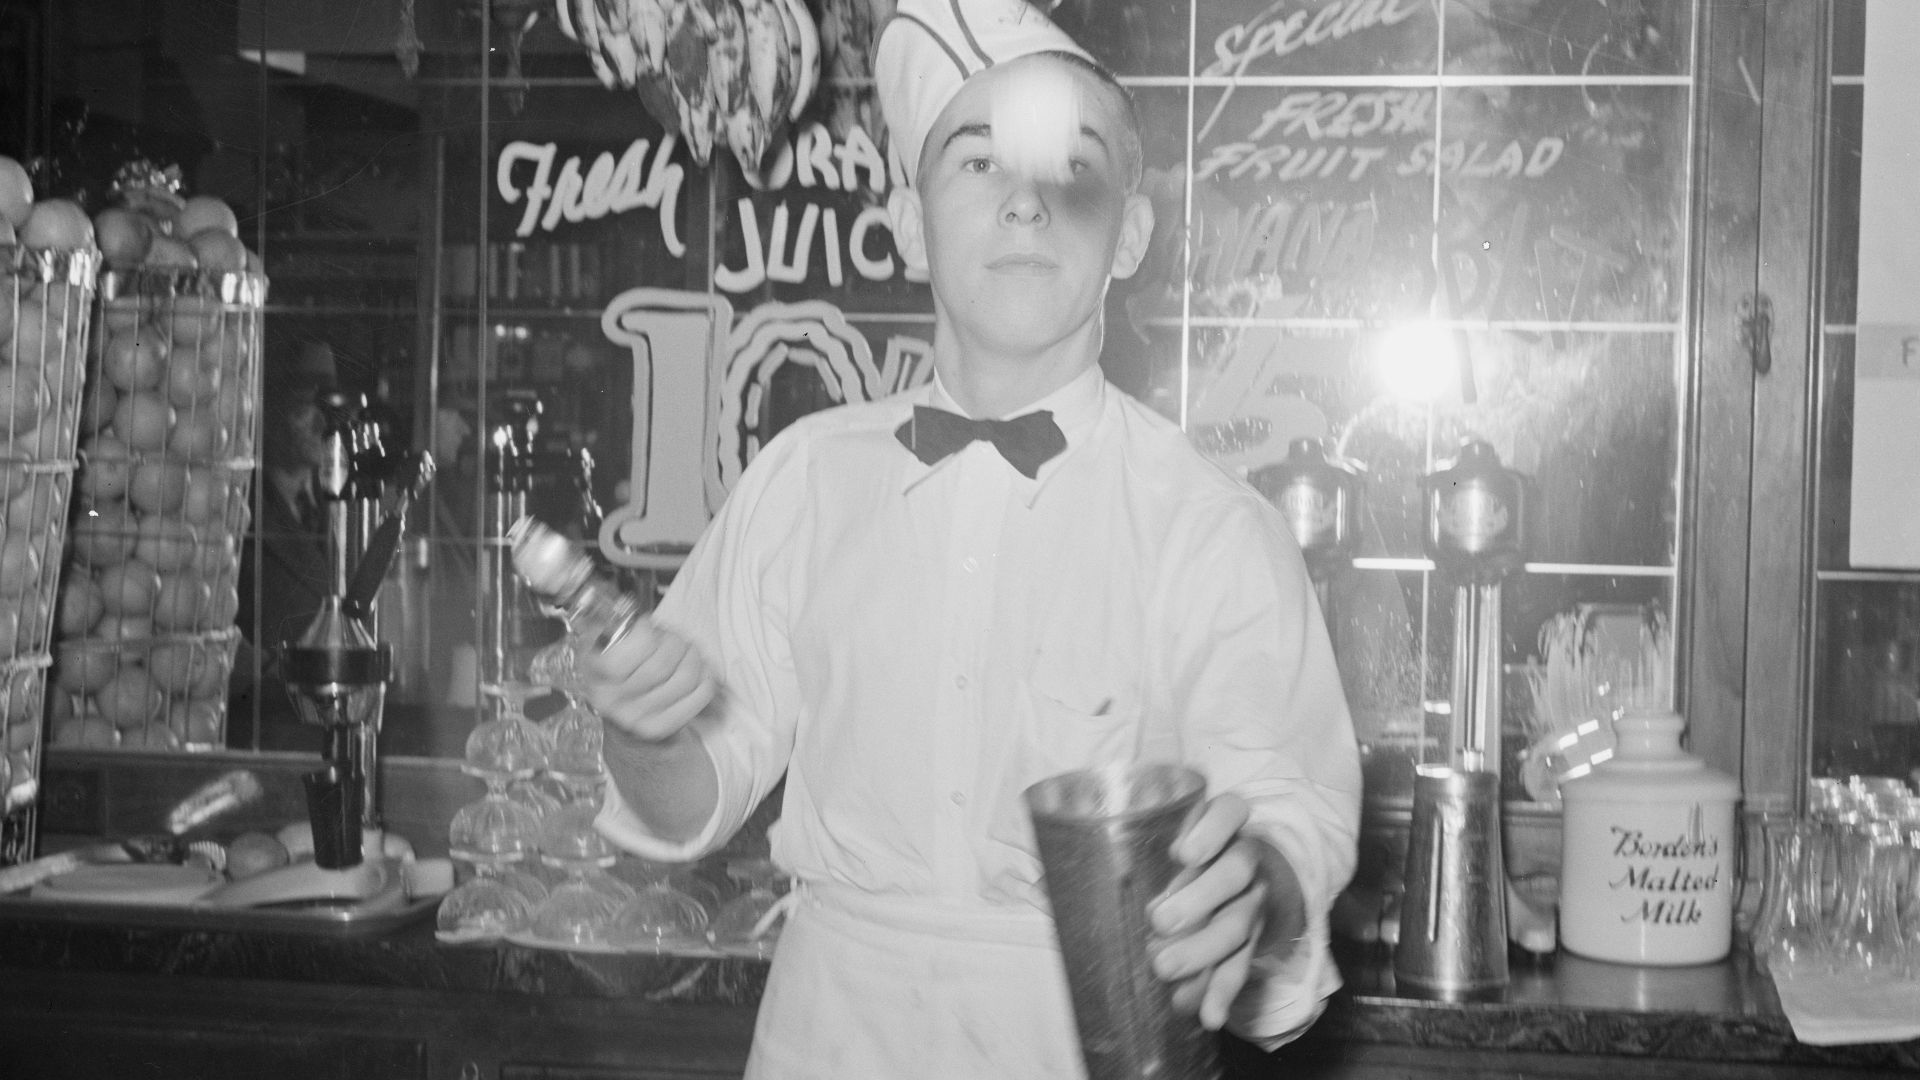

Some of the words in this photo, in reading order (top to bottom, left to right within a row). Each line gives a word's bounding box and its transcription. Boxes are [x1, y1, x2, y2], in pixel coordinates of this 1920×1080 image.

[1248, 91, 1434, 141] FRESH
[1196, 142, 1388, 181] FRUIT
[1396, 137, 1564, 179] SALAD
[498, 137, 685, 258] Fresh
[714, 197, 930, 293] JUIC
[1610, 826, 1719, 857] Borden's
[1608, 862, 1719, 892] Malted
[1620, 898, 1702, 924] Milk
